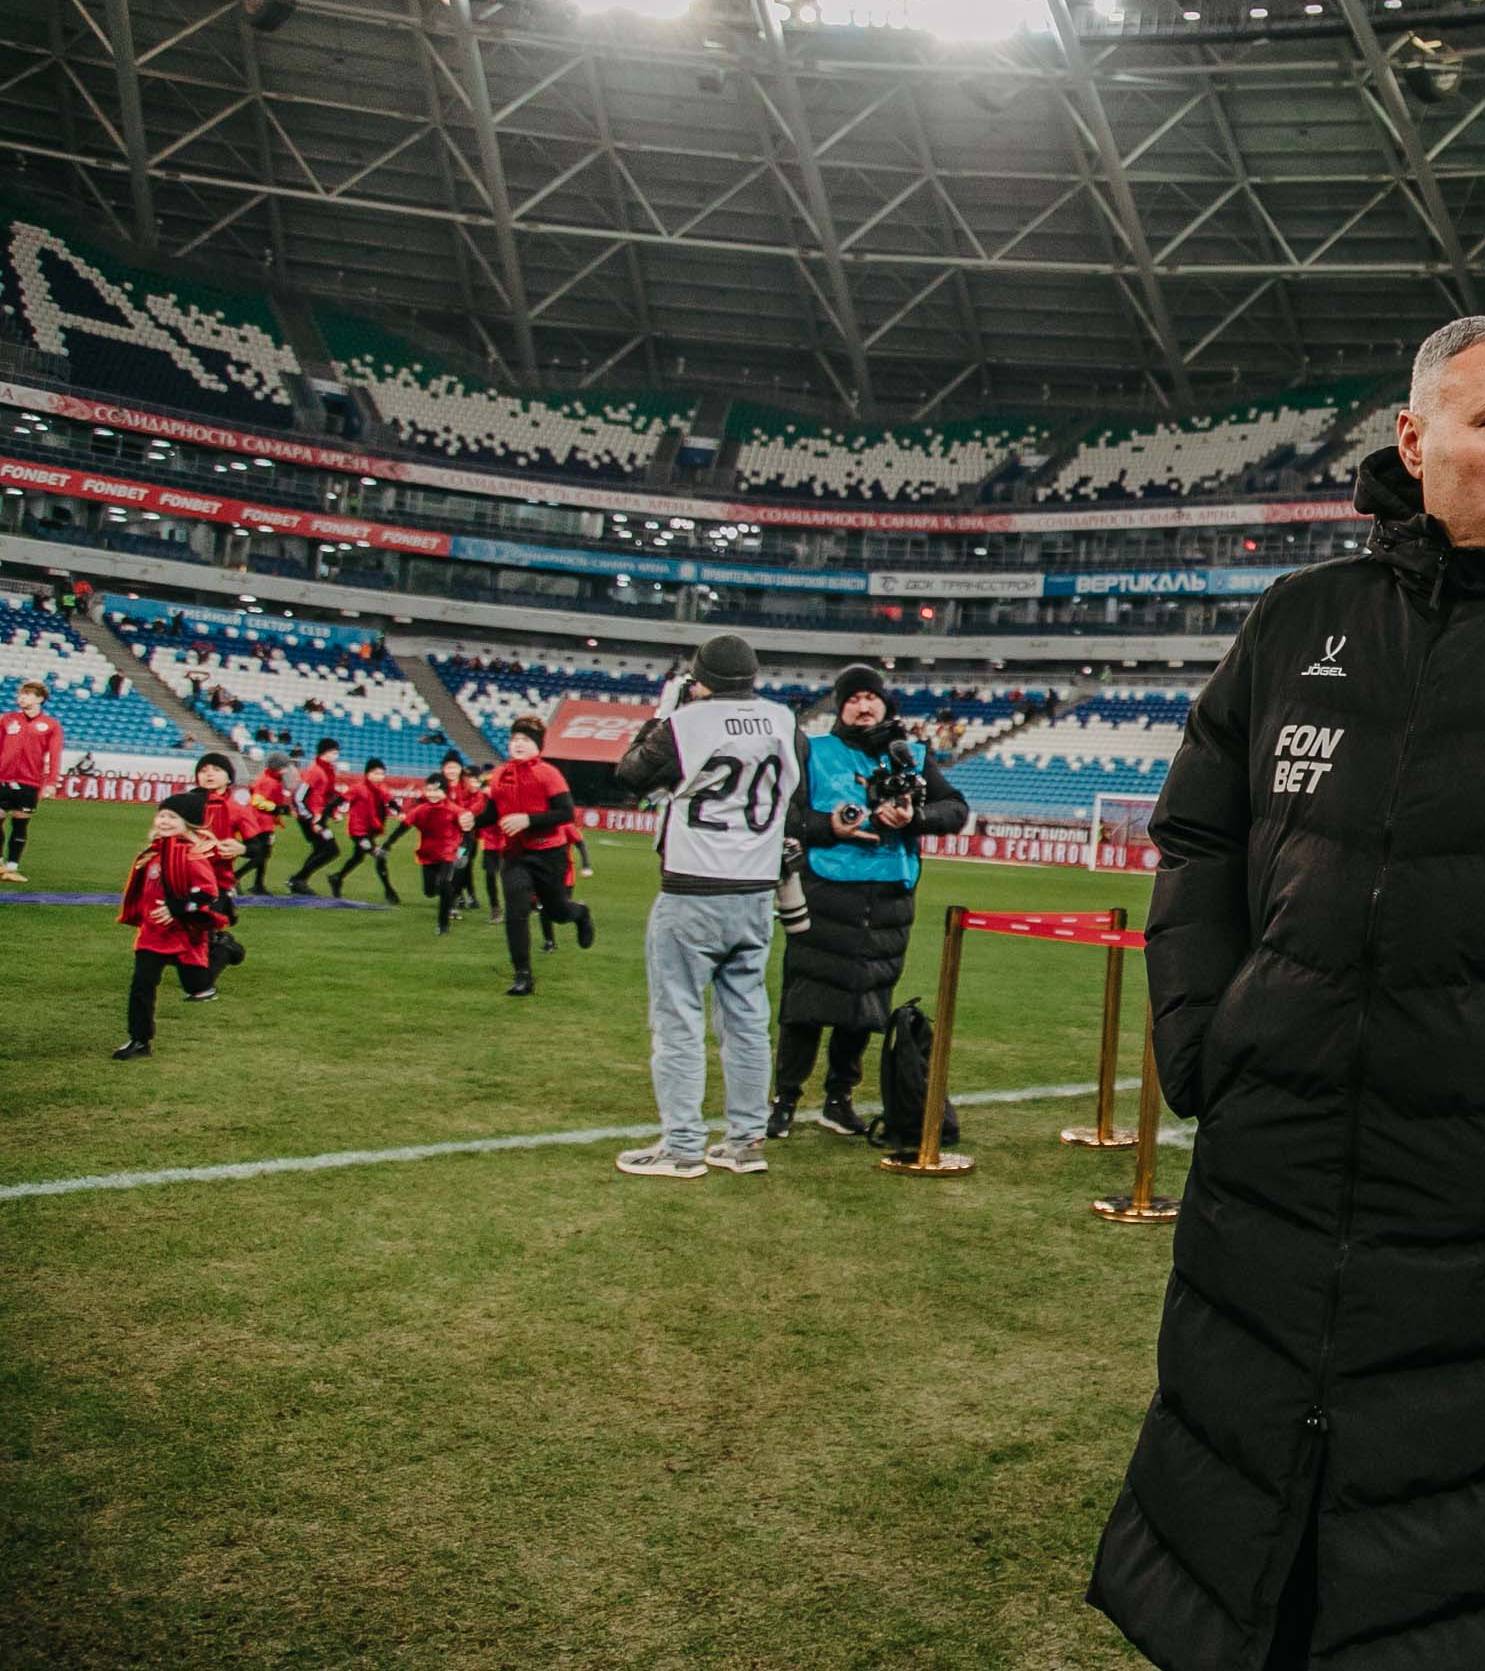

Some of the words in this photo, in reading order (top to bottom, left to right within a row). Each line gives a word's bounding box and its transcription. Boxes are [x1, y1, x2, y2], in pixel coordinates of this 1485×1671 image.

[1, 463, 70, 487] FONBET
[82, 478, 149, 501] FONBET
[160, 492, 223, 514] FONBET
[241, 507, 300, 528] FONBET
[310, 519, 371, 539] FONBET
[380, 529, 441, 550] FONBET
[1300, 663, 1348, 677] JÖGEL
[724, 718, 774, 736] ФОТО
[1274, 725, 1345, 759] FON
[688, 755, 783, 833] 20
[1273, 761, 1335, 795] BET
